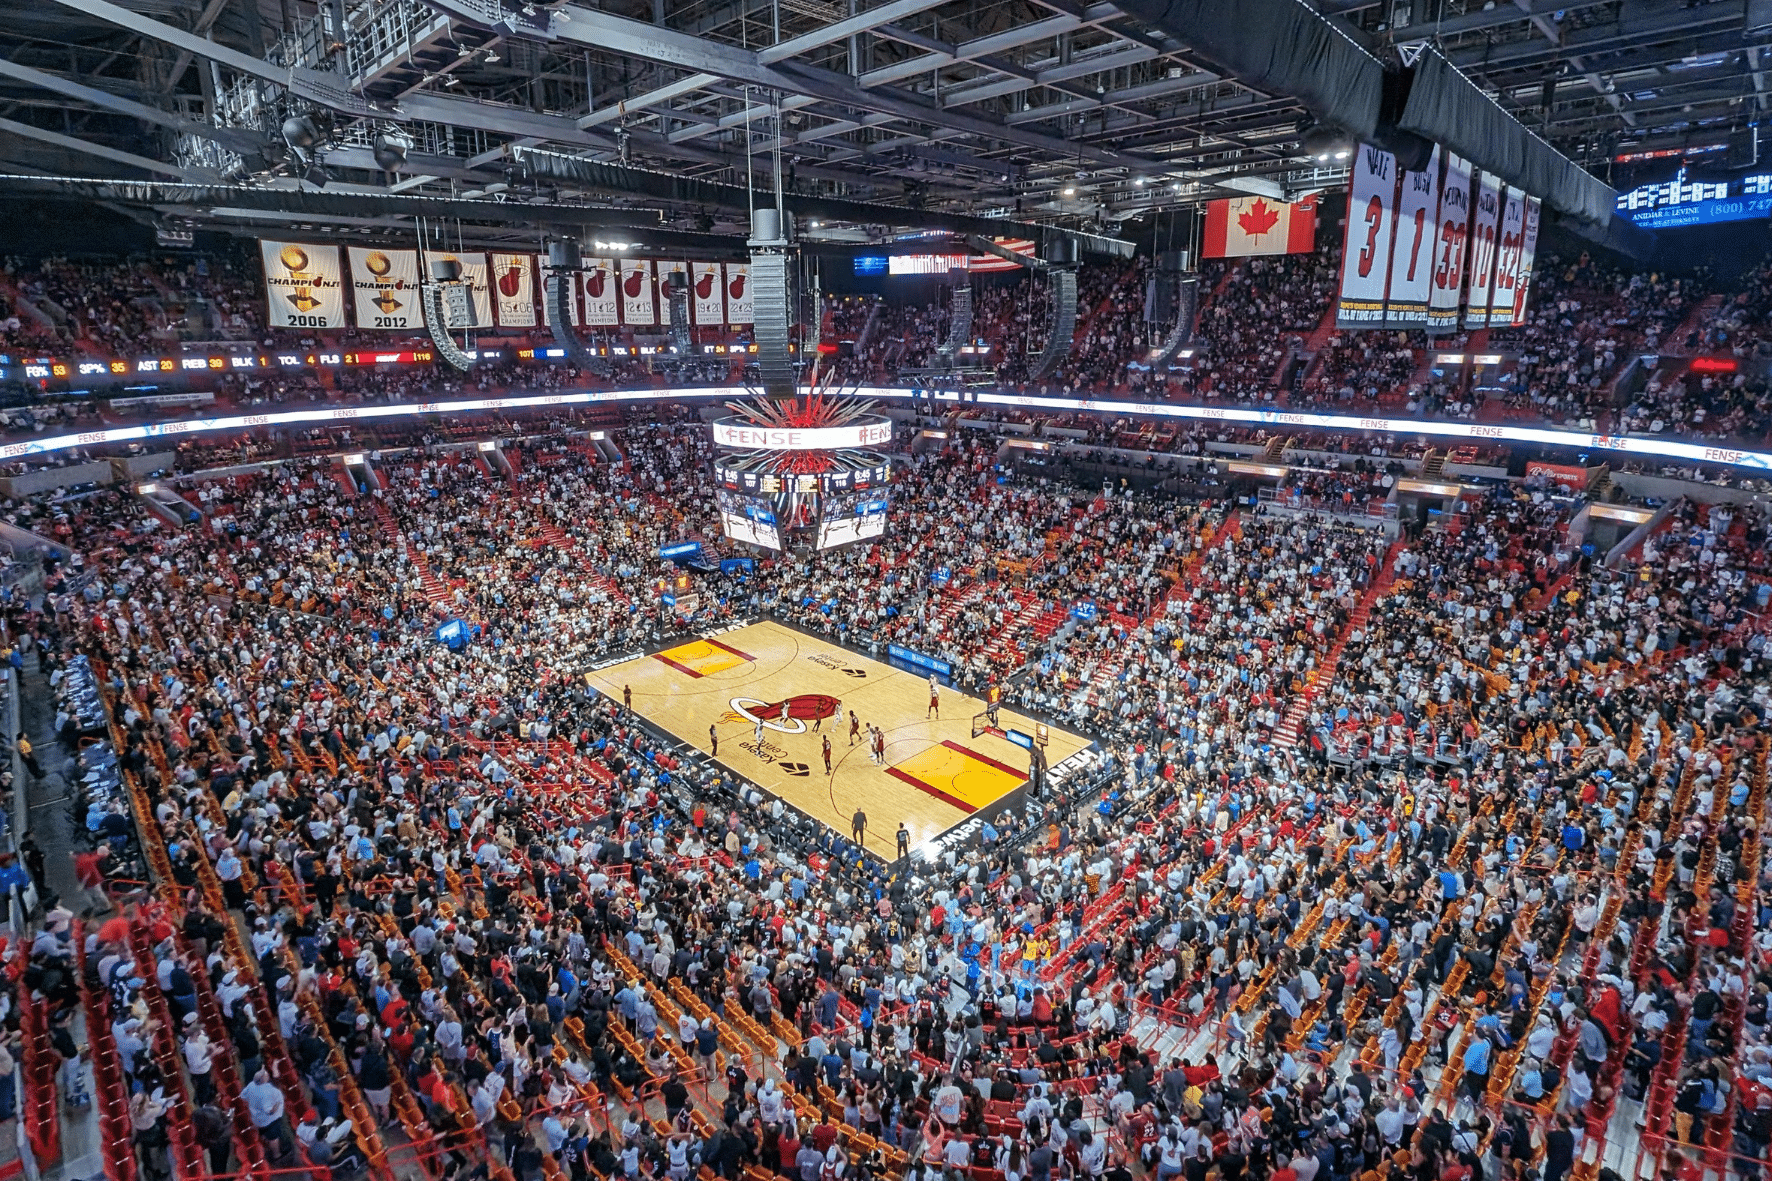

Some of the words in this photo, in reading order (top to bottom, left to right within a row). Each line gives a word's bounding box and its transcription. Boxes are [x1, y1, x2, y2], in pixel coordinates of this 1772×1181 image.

[1710, 202, 1743, 216] (800)
[1358, 194, 1382, 278] 3
[1406, 207, 1426, 282] 1
[1435, 219, 1466, 290] 33
[288, 315, 327, 327] 2006
[374, 317, 407, 328] 2012
[26, 366, 49, 378] FG%
[53, 365, 66, 376] 53
[79, 364, 106, 374] 3P%
[112, 362, 126, 372] 35
[138, 360, 158, 371] AST
[160, 360, 172, 370] 20
[182, 358, 206, 369] REB
[232, 357, 254, 367] BLK
[278, 356, 300, 365] TOL
[308, 356, 314, 364] 4
[320, 354, 340, 364] FLS
[345, 355, 352, 363] 2
[416, 352, 430, 360] 116
[243, 416, 268, 424] FENSE
[332, 410, 358, 418] FENSE
[1202, 410, 1225, 418] FENSE
[1279, 414, 1304, 424] FENSE
[164, 422, 188, 432] FENSE
[1360, 420, 1388, 429] FENSE
[77, 432, 106, 443] FENSE
[726, 428, 802, 445] FENSE
[1470, 426, 1503, 437] FENSE
[1591, 436, 1628, 450] FENSE
[4, 444, 28, 456] FENSE
[1704, 448, 1742, 462] FENSE
[738, 741, 778, 764] Kaseya
[1046, 748, 1099, 788] HEAT
[929, 816, 984, 850] betwa
[983, 1002, 994, 1010] 22
